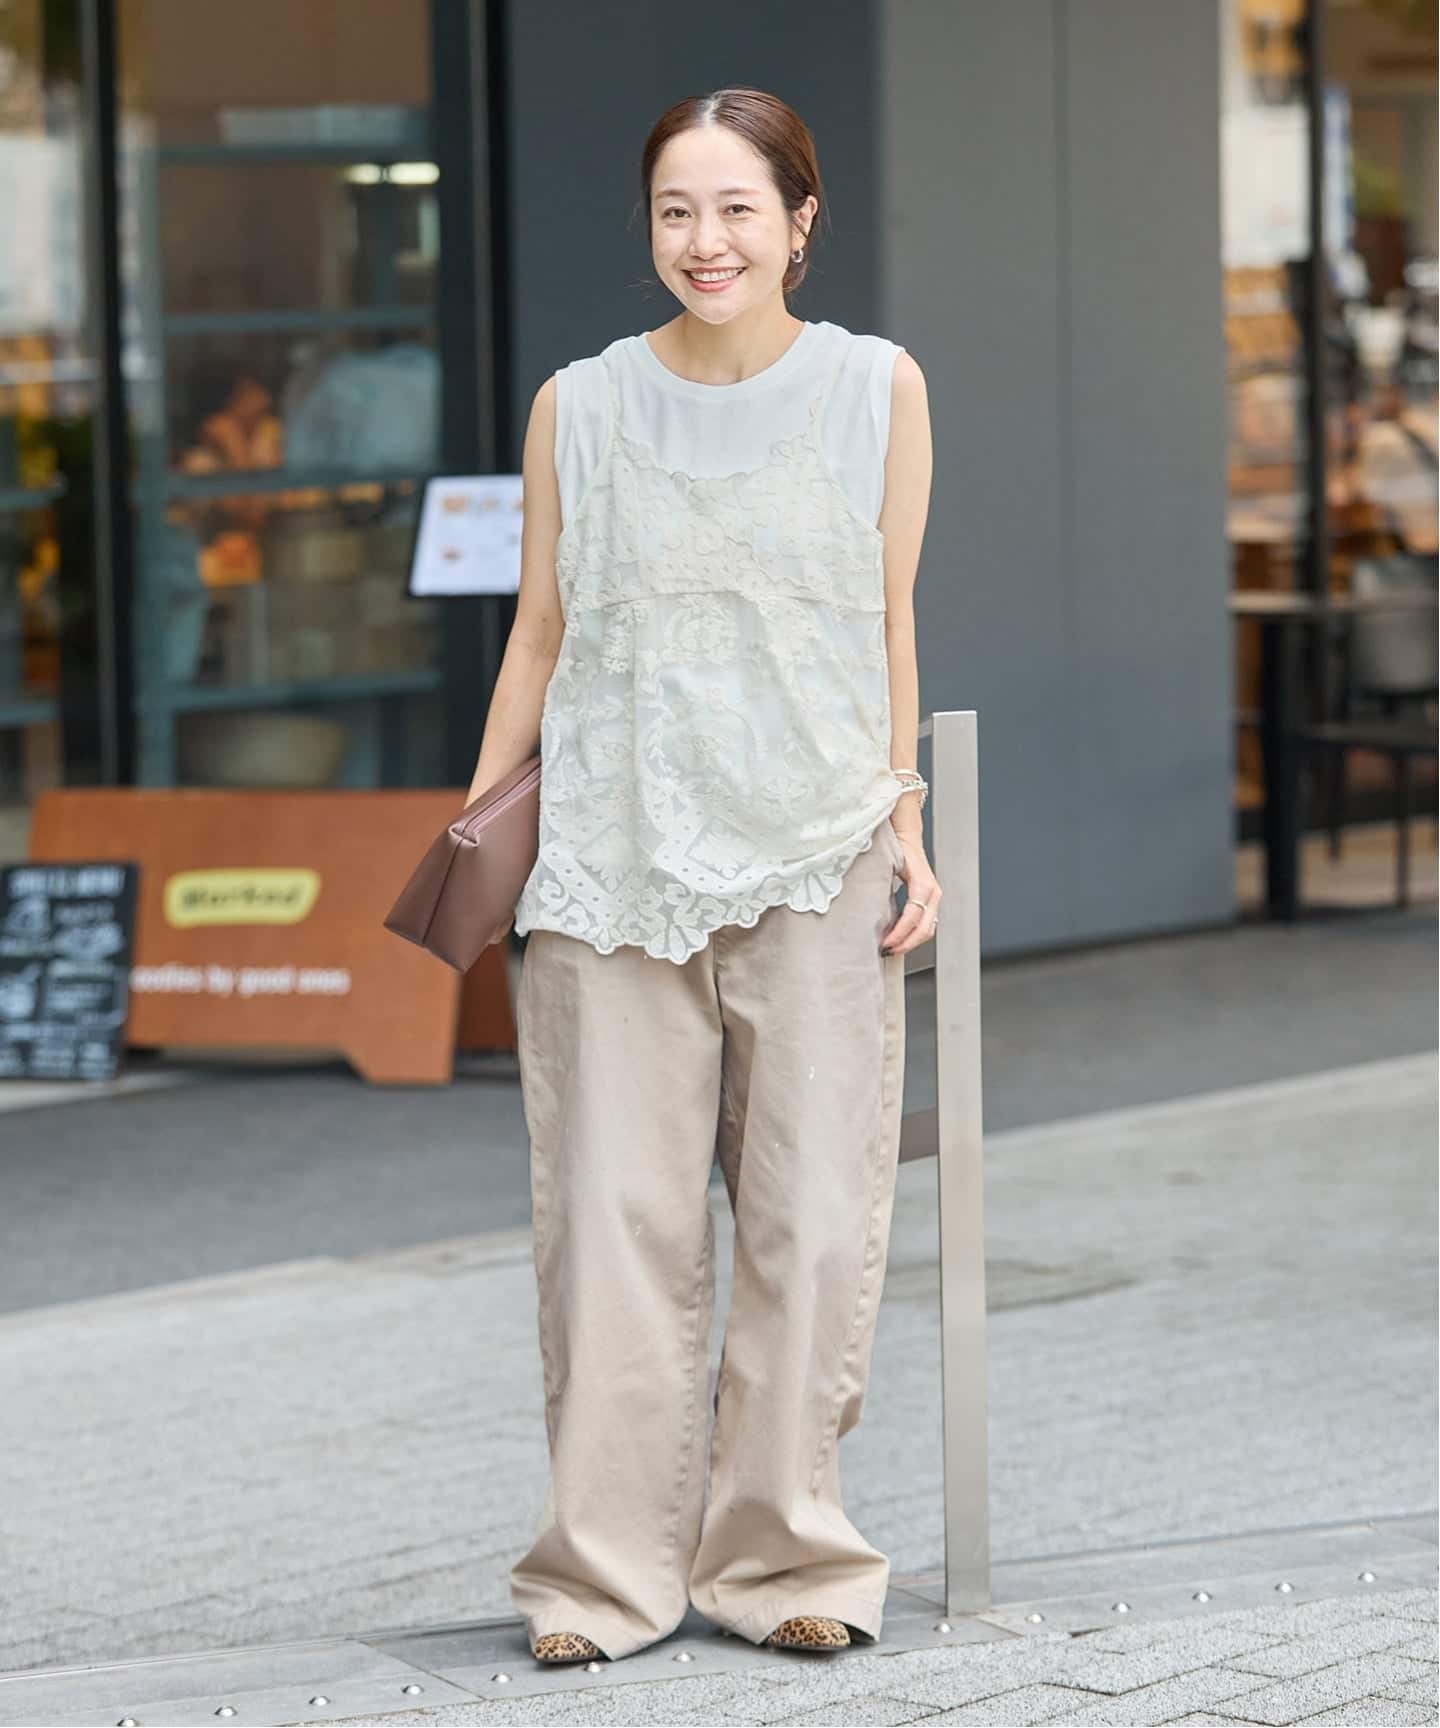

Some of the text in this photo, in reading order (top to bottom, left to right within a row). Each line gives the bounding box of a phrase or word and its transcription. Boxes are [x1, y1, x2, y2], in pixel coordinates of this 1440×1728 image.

[206, 963, 234, 997] by
[238, 963, 295, 998] good
[298, 967, 351, 995] ones
